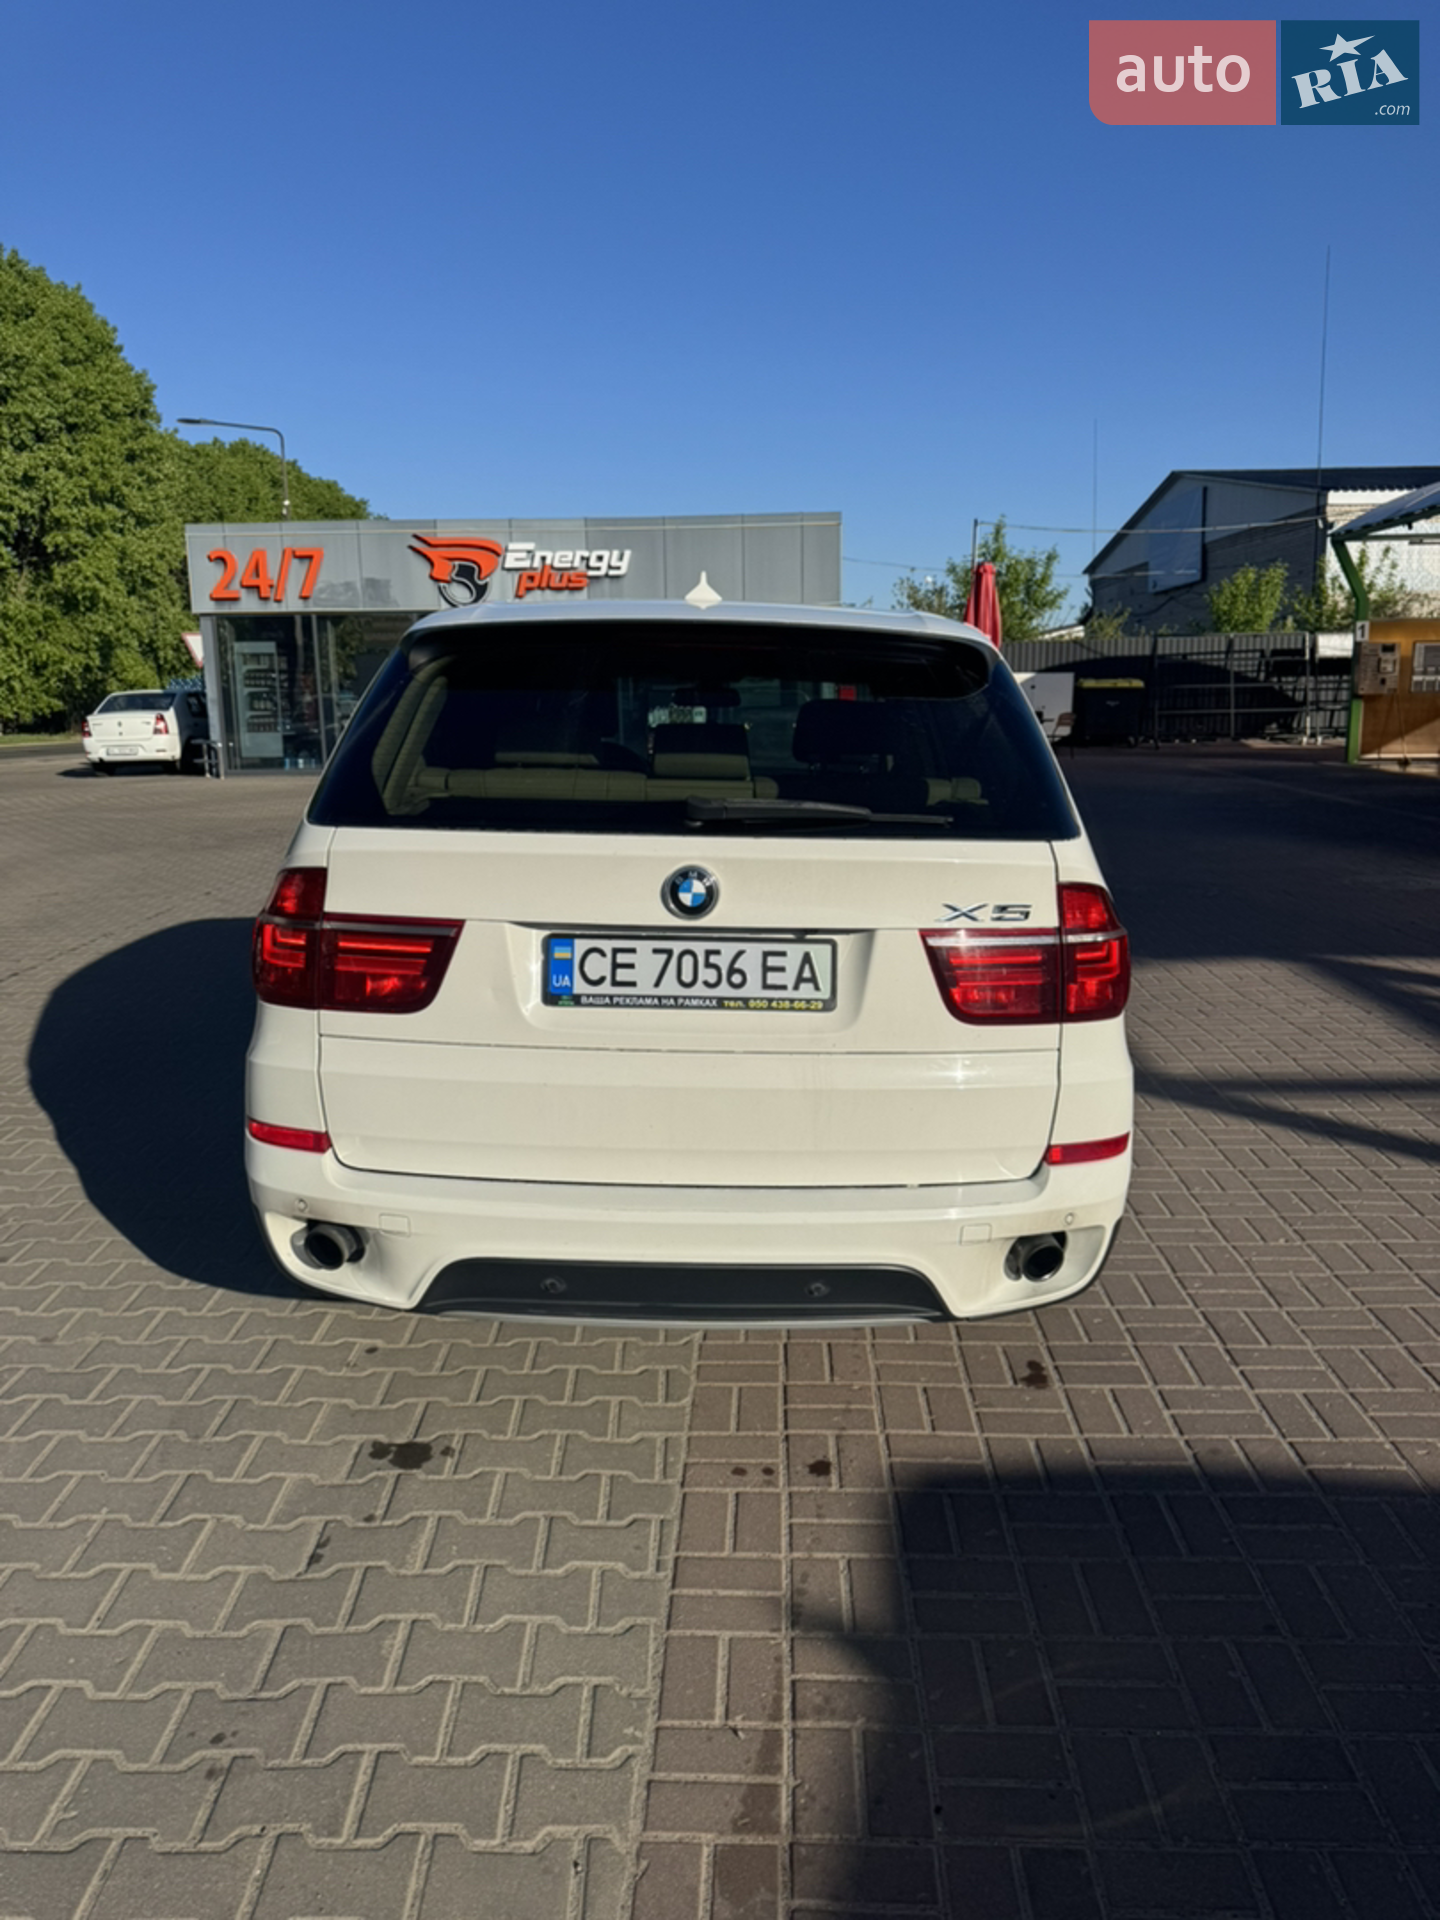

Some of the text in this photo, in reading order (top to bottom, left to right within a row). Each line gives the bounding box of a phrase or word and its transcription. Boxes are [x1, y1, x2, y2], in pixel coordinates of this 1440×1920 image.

[503, 542, 631, 577] Energy
[208, 547, 324, 601] 24/7
[515, 564, 590, 598] plus
[1358, 623, 1366, 639] 1
[936, 903, 1032, 922] X5
[552, 975, 571, 988] UA
[578, 946, 822, 992] CE 7056 EA
[580, 995, 611, 1005] ВАША
[613, 996, 660, 1007] РЕКЛАМА
[661, 997, 675, 1007] НА
[677, 997, 718, 1008] РАМКАХ
